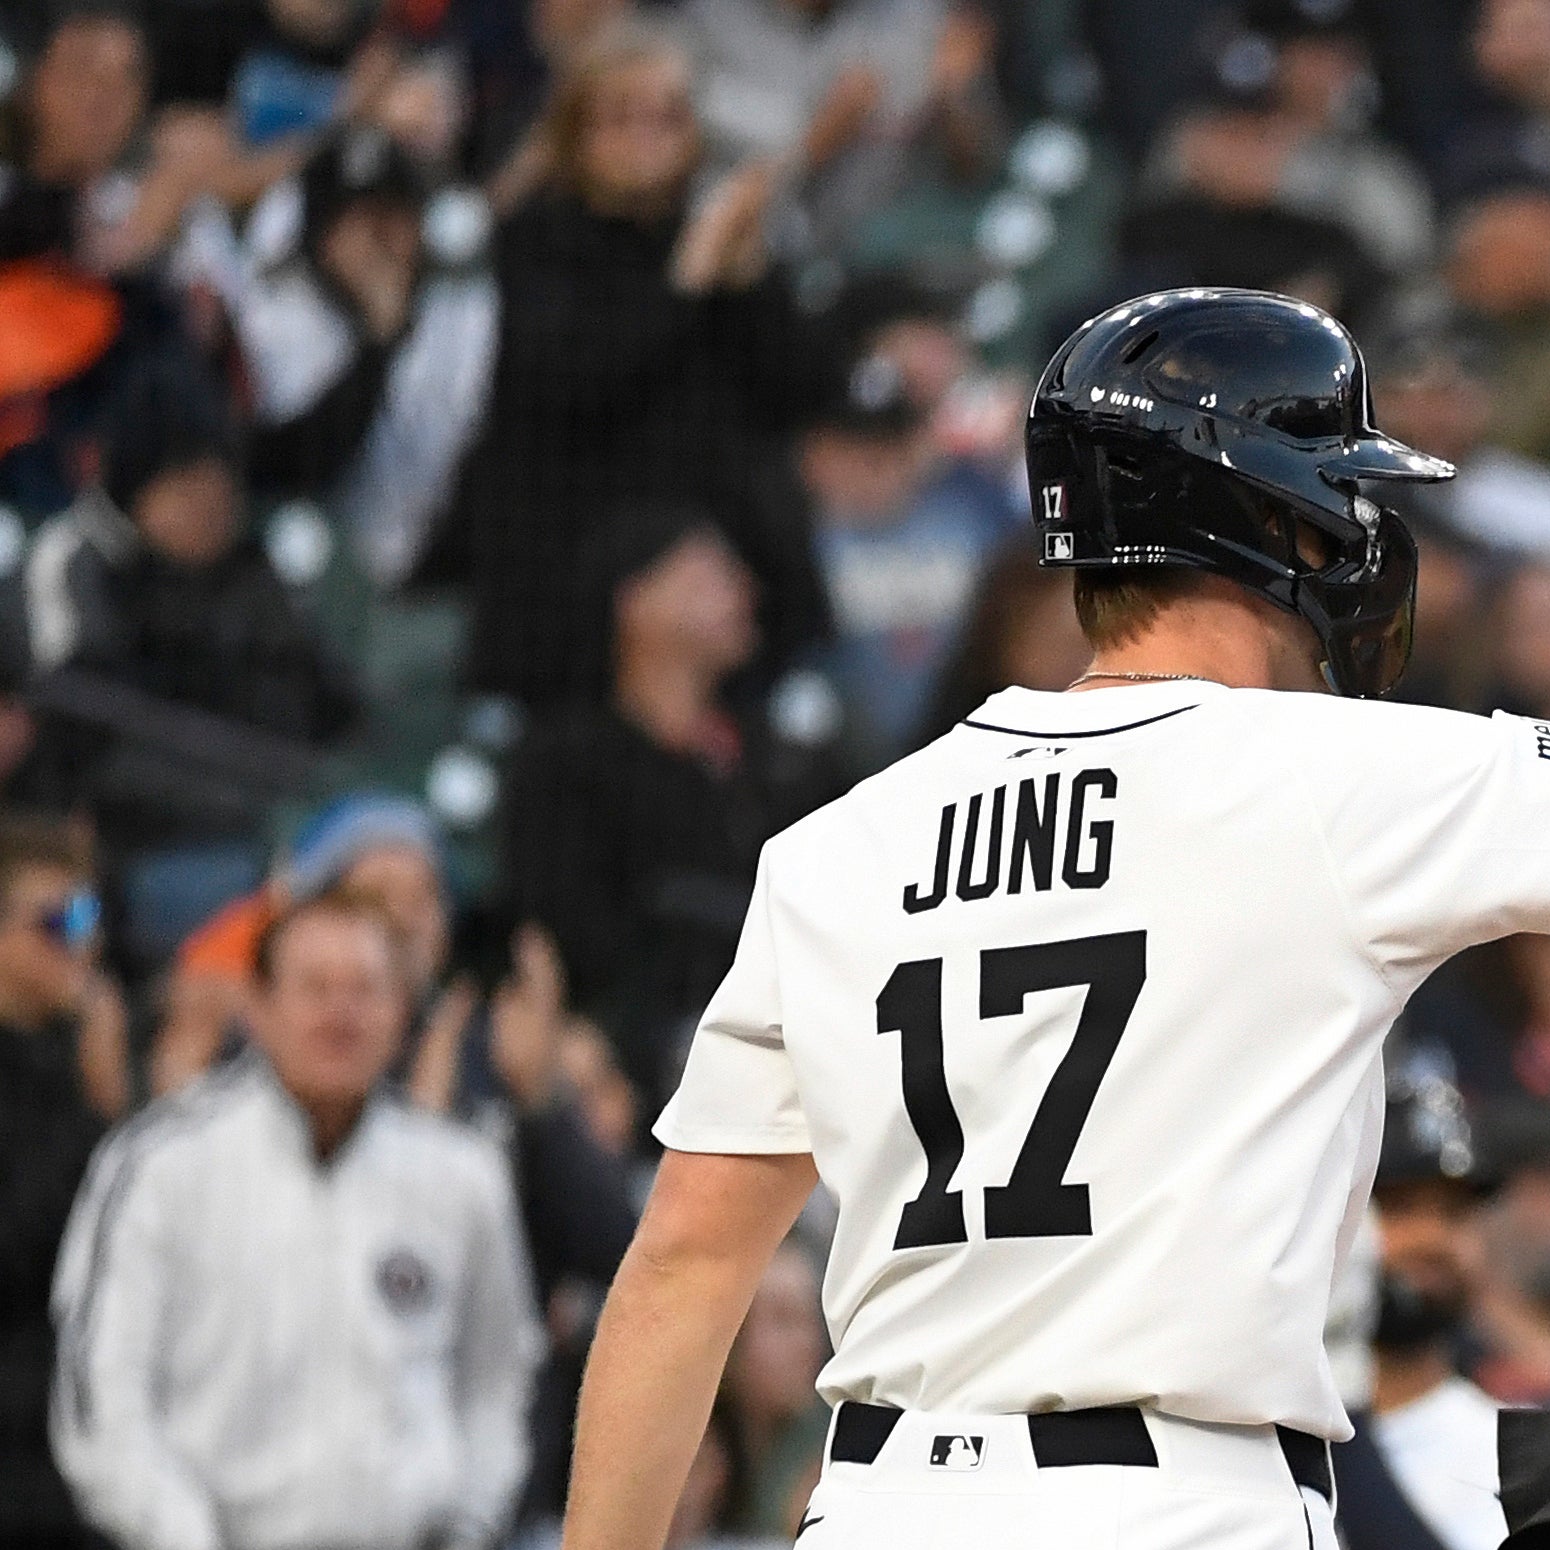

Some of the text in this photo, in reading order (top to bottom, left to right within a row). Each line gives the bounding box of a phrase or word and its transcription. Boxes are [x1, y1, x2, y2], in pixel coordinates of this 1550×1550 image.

[1042, 486, 1063, 519] 17
[902, 768, 1118, 915] JUNG
[876, 929, 1148, 1251] 17
